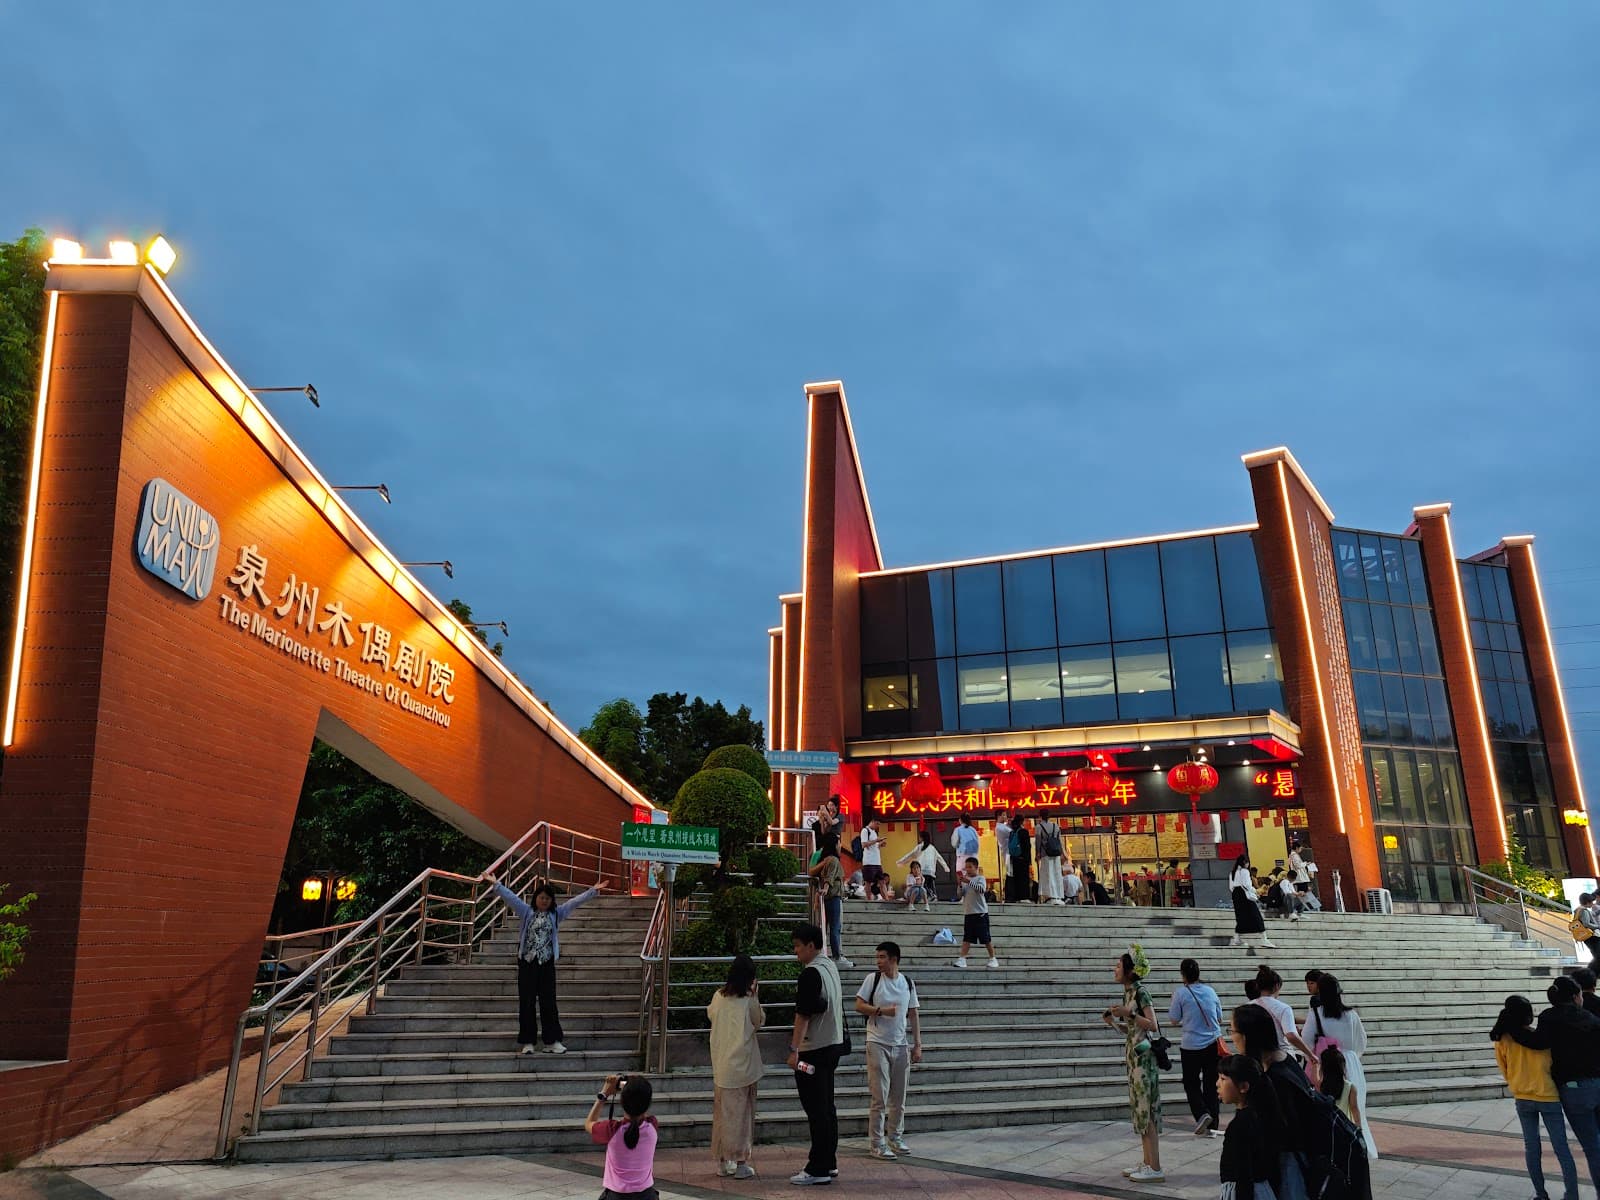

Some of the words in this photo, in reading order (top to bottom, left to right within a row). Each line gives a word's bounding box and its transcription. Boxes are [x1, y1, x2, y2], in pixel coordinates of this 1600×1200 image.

[220, 593, 250, 629] The
[250, 612, 331, 672] Marionette
[336, 657, 383, 695] Theatre
[386, 683, 401, 705] Of
[401, 691, 451, 727] Quanzhou
[230, 544, 455, 704] 泉州木偶剧院
